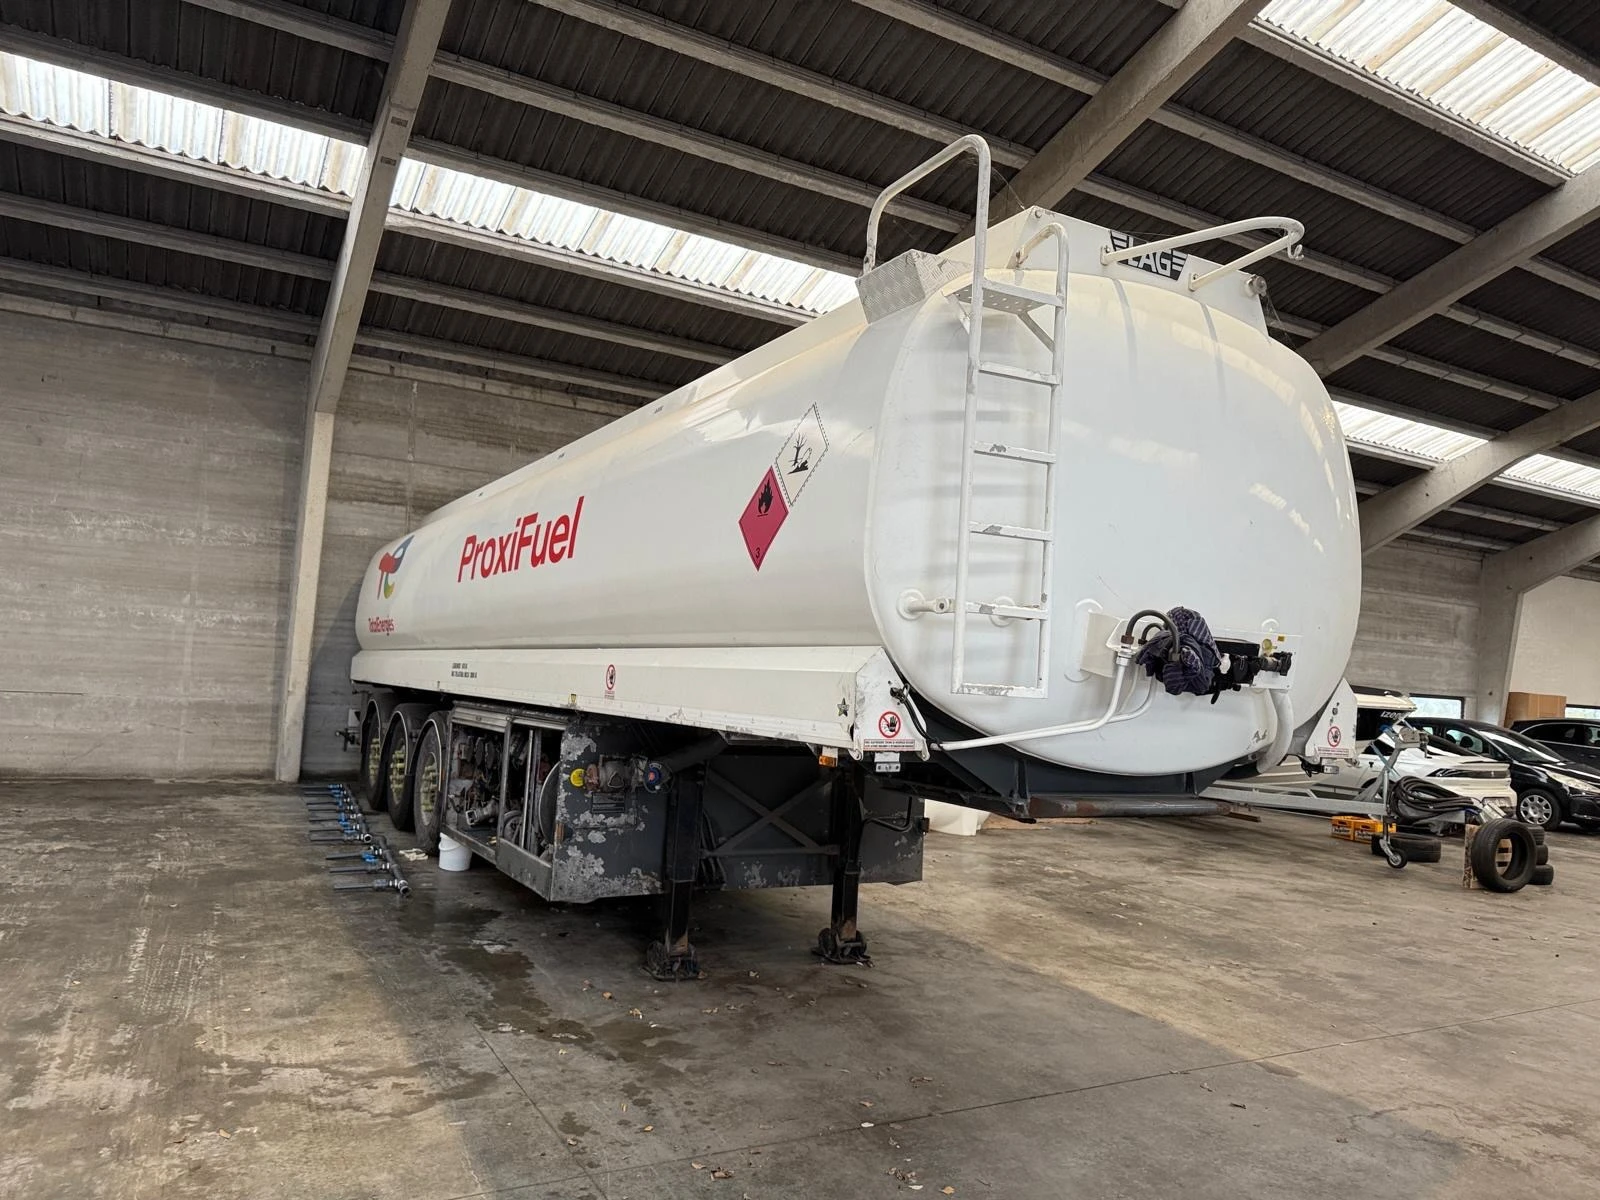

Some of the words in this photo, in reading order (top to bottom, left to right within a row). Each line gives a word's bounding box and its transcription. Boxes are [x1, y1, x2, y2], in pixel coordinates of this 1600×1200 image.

[1128, 236, 1172, 277] LAG
[457, 495, 585, 583] ProxiFuel
[755, 547, 761, 559] 3
